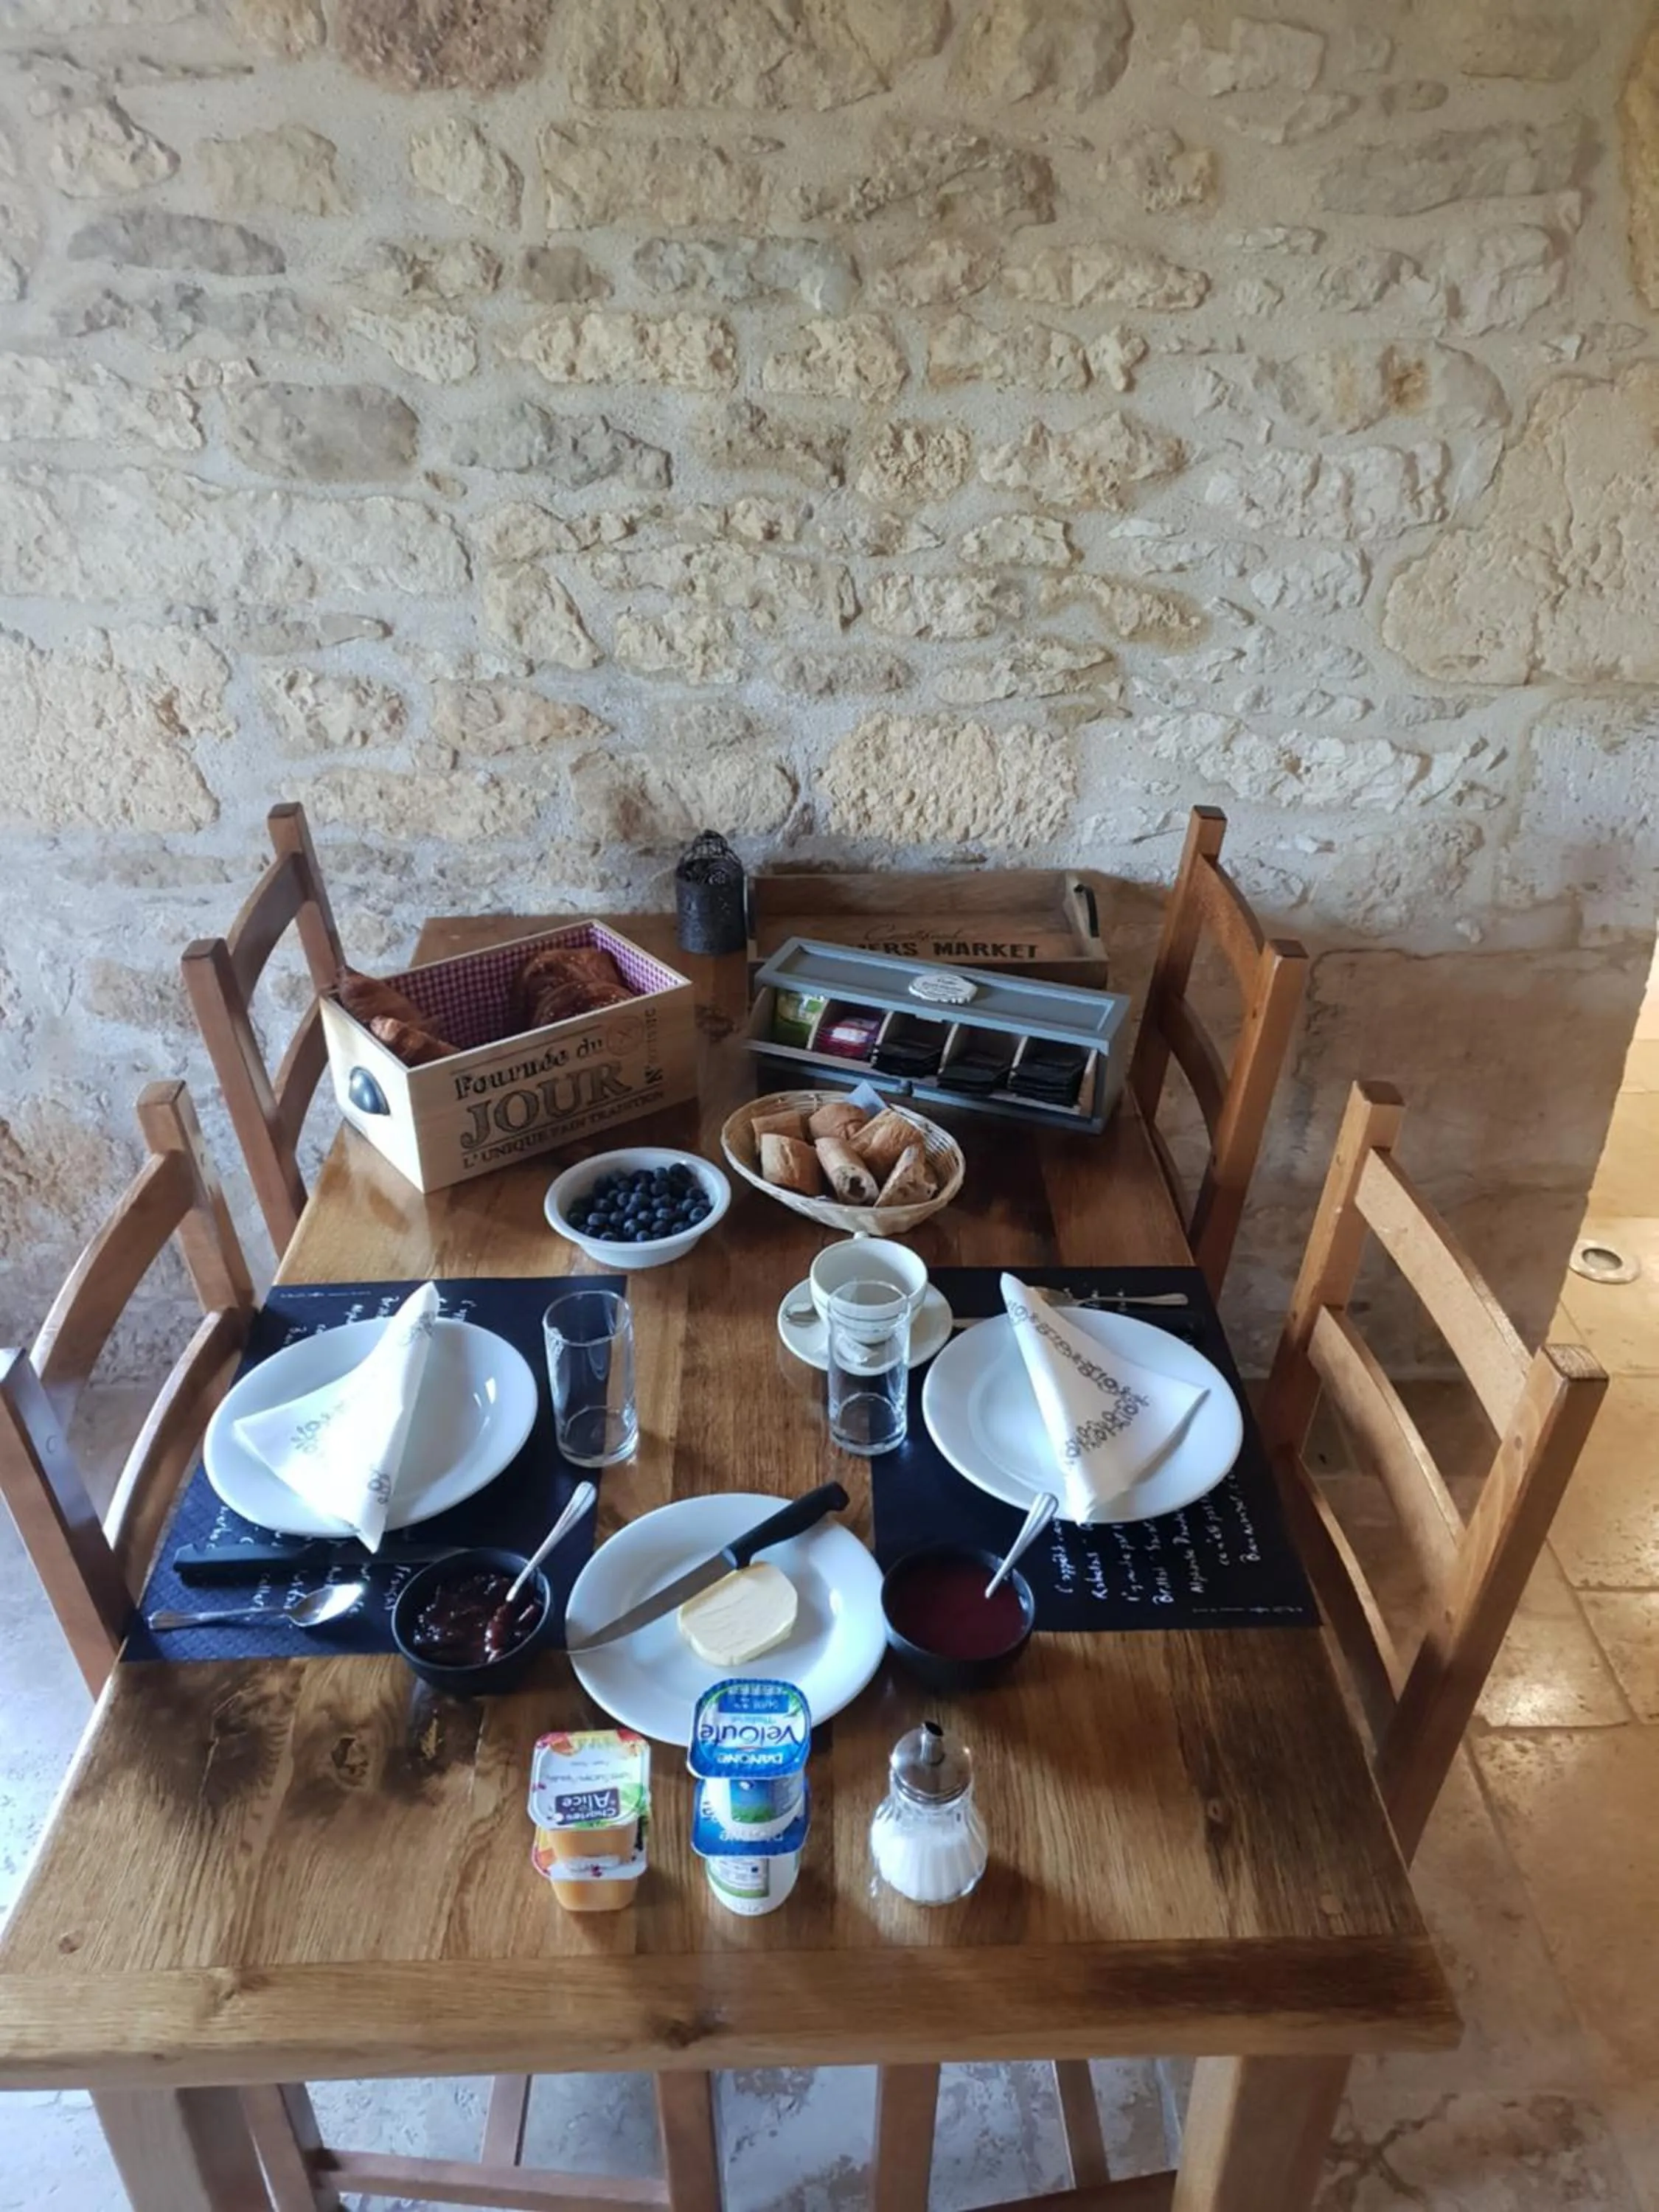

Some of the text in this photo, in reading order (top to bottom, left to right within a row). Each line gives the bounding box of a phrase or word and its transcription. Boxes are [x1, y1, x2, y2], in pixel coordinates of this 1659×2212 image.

[933, 941, 1039, 959] MARKET
[576, 1037, 602, 1059] du
[459, 1060, 633, 1149] JOUR
[716, 1753, 784, 1766] DANONE
[560, 1792, 611, 1811] Alice
[566, 1807, 616, 1821] Charles
